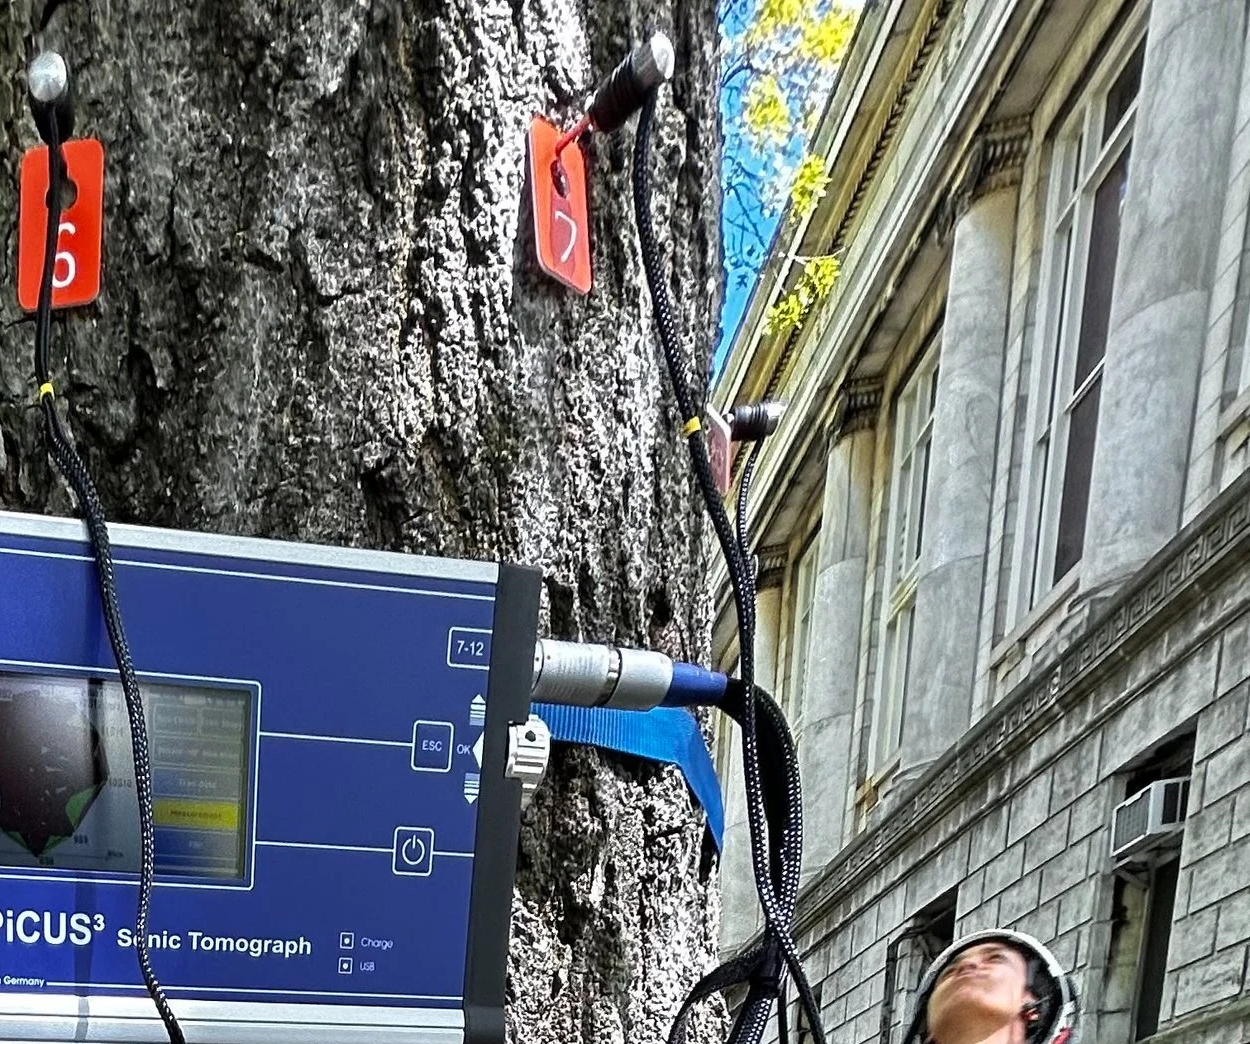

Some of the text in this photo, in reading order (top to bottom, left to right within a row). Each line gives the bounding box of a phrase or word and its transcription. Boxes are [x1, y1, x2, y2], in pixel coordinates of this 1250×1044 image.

[554, 210, 577, 263] 7
[52, 222, 76, 288] 6
[457, 640, 483, 656] 7-12
[421, 739, 443, 752] ESC
[456, 743, 471, 756] OK
[188, 931, 312, 957] Tomograph
[361, 937, 394, 949] Charge
[360, 961, 375, 971] USB
[3, 975, 45, 988] Germany
